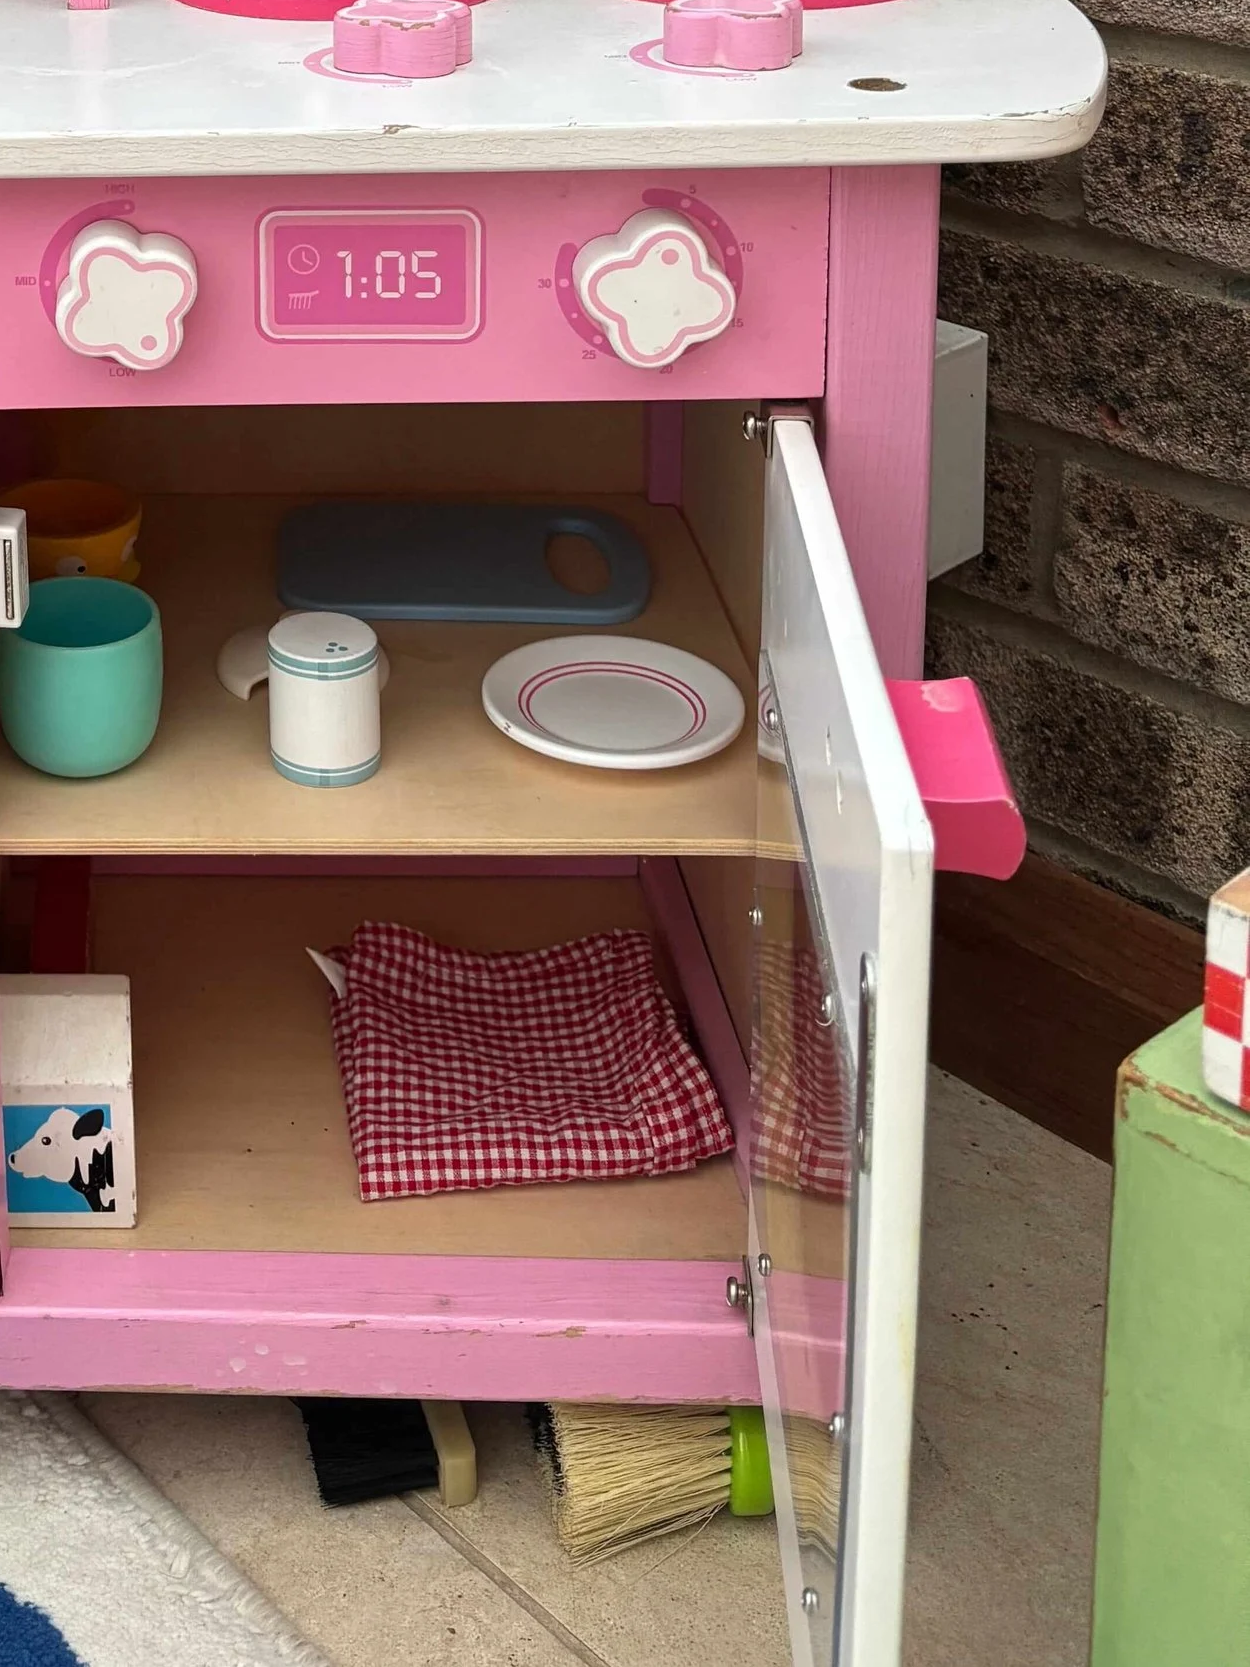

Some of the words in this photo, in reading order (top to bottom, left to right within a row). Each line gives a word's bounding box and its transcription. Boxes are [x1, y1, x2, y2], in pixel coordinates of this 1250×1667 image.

[741, 242, 754, 253] 10
[336, 250, 442, 299] 1:05
[14, 276, 37, 287] MID
[537, 278, 552, 289] 30
[581, 350, 596, 360] 25
[109, 368, 136, 378] LOW
